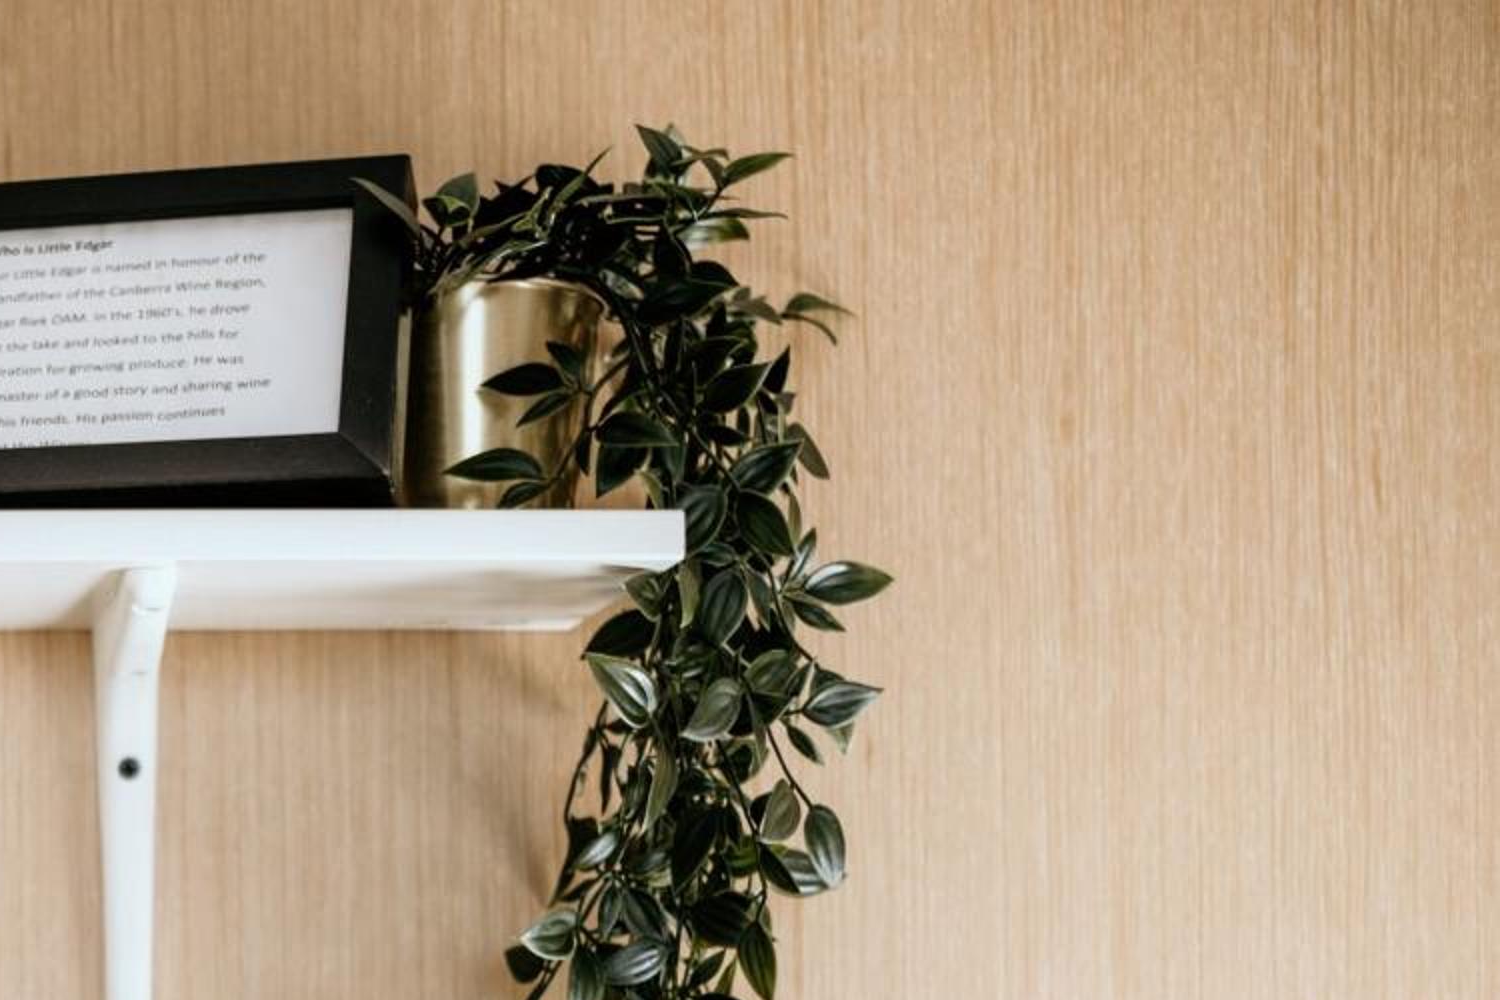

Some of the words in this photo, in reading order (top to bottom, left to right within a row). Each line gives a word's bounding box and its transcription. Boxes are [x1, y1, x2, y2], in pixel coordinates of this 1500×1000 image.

[38, 242, 72, 254] Little
[75, 240, 113, 252] Edgar
[13, 268, 46, 281] Little
[51, 266, 87, 278] Edgar
[105, 260, 150, 273] named
[171, 256, 220, 268] honour
[242, 252, 265, 264] the
[83, 286, 106, 300] the
[109, 283, 172, 297] Canberra
[176, 280, 211, 292] Wine
[110, 308, 132, 320] the
[189, 304, 207, 316] he
[210, 303, 250, 316] drove
[6, 341, 28, 352] the
[32, 340, 60, 350] lake
[64, 338, 90, 348] and
[93, 334, 139, 347] looked
[161, 332, 184, 344] the
[187, 328, 215, 340] hills
[219, 328, 239, 340] for
[46, 364, 65, 375] for
[69, 361, 124, 376] growing
[194, 355, 213, 366] He
[217, 355, 244, 365] was
[73, 386, 109, 400] good
[114, 384, 148, 396] story
[151, 383, 178, 395] and
[182, 380, 232, 393] sharing
[236, 377, 272, 388] wine
[76, 412, 97, 424] His
[102, 411, 153, 424] passion
[157, 407, 226, 420] continues
